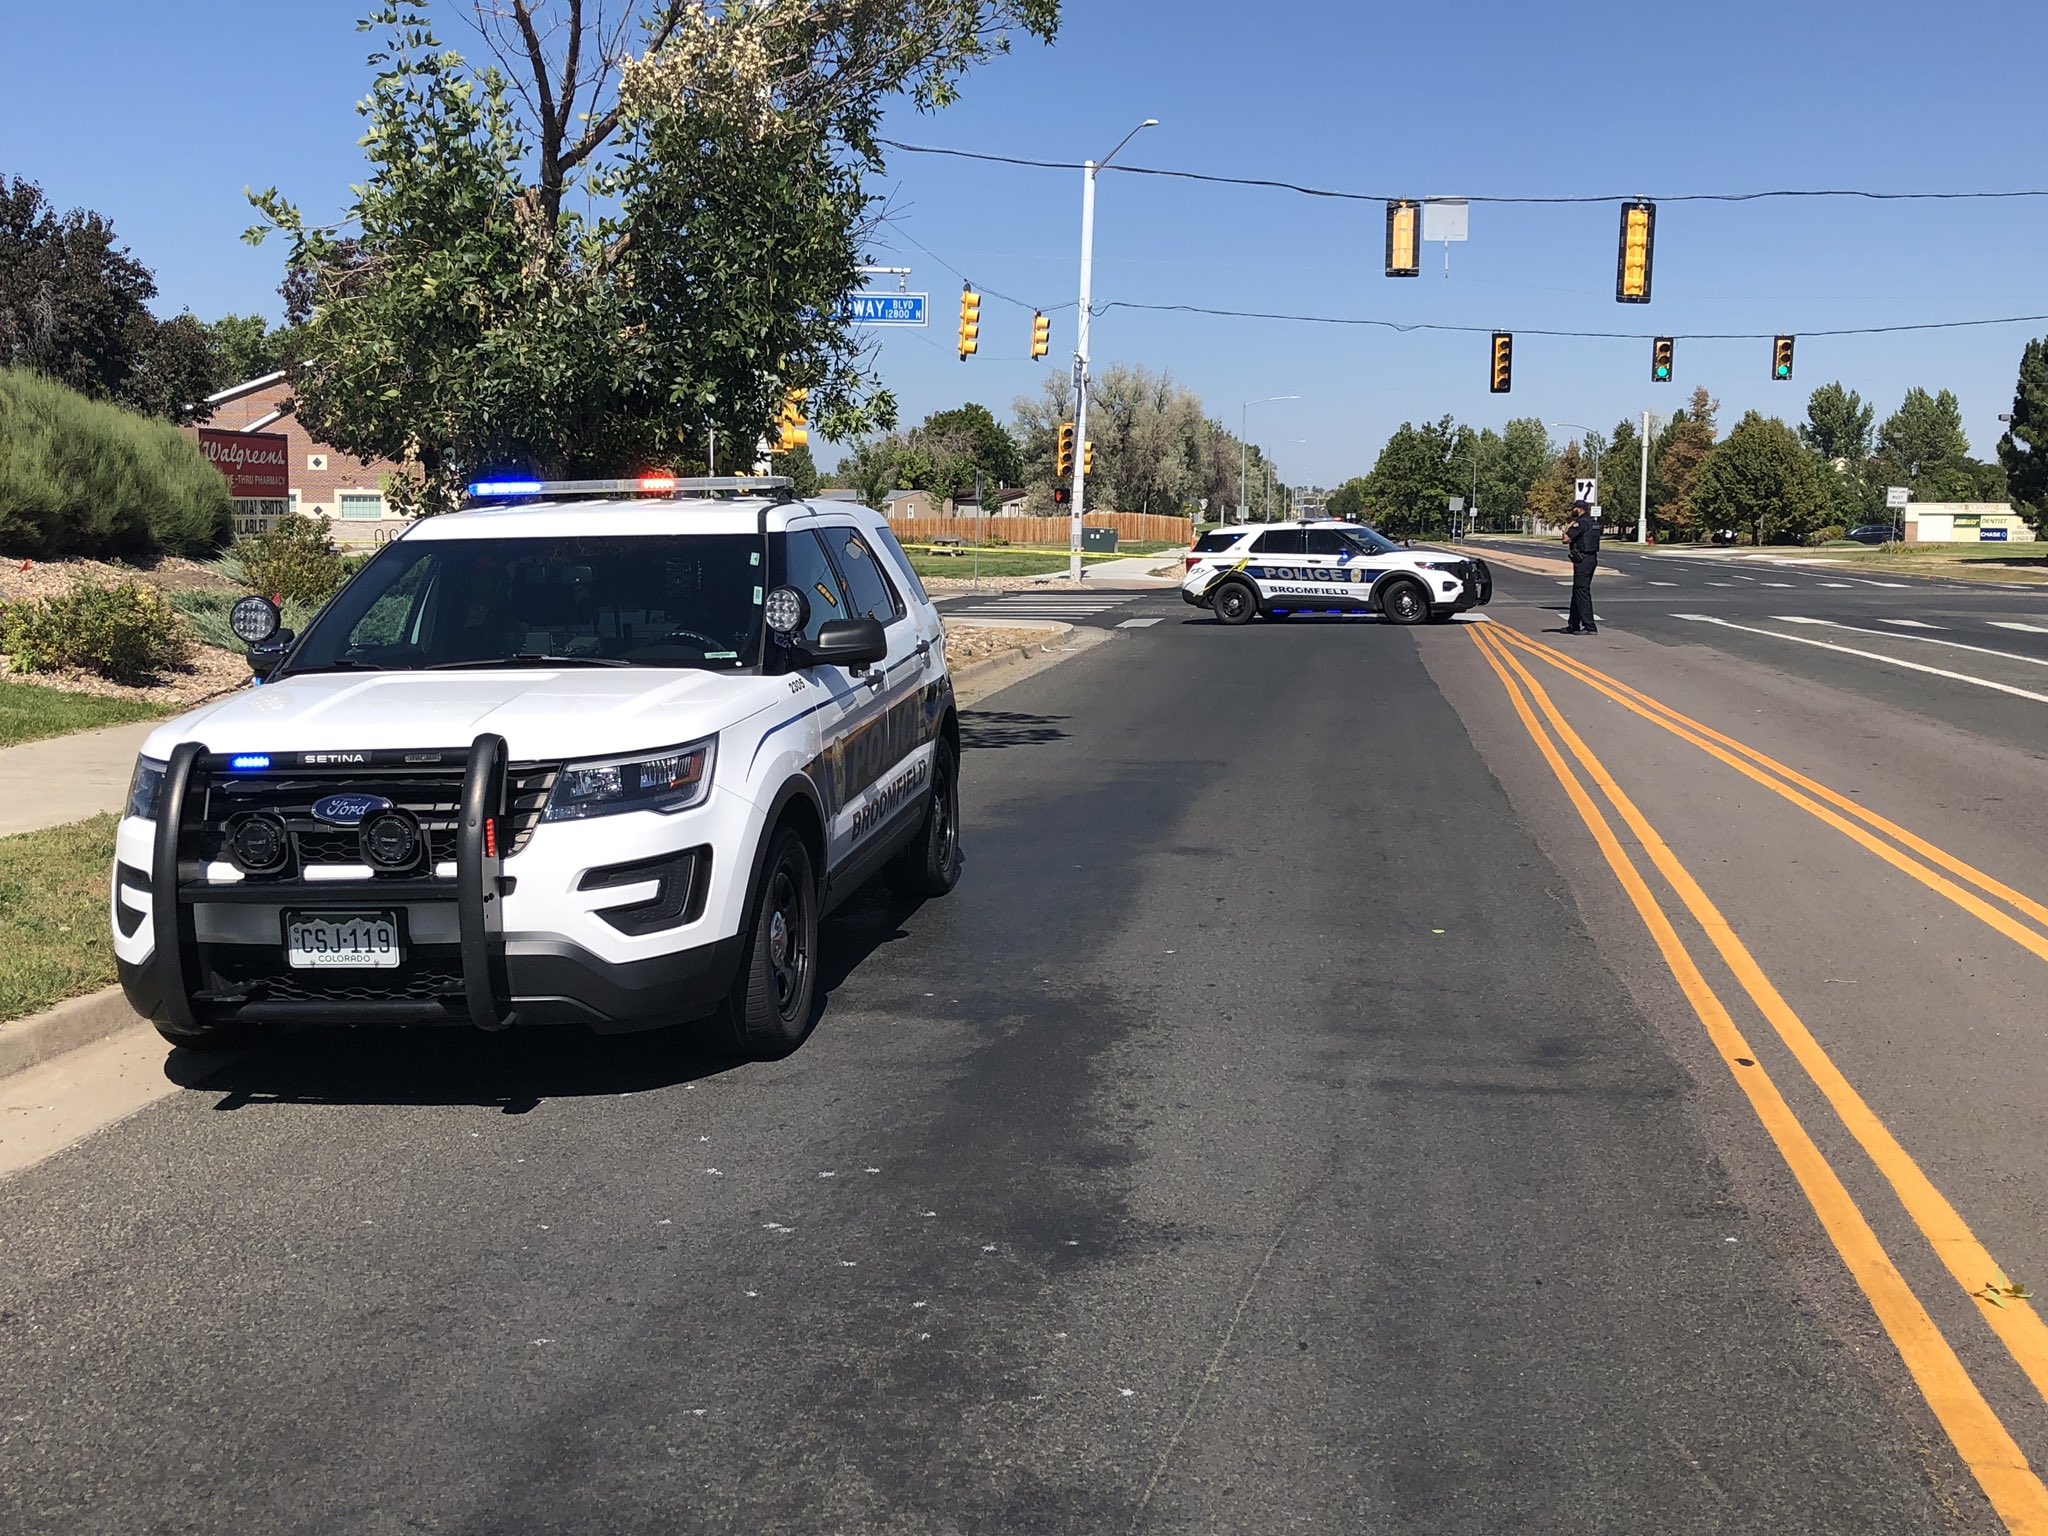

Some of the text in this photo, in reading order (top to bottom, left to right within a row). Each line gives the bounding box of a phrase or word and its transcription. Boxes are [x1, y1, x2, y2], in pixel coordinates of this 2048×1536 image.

[892, 300, 914, 310] BLVD
[885, 309, 922, 319] 12800 N
[202, 440, 286, 470] Walgreens
[254, 475, 286, 486] PHARMACY
[260, 500, 284, 515] SHOTS
[1263, 567, 1345, 581] POLICE
[1269, 586, 1349, 595] BROOMFIELD
[788, 678, 807, 695] 2305
[304, 754, 365, 764] SETINA
[851, 759, 928, 842] BROOMFIELD
[326, 799, 370, 816] Ford
[318, 955, 371, 963] COLORADO
